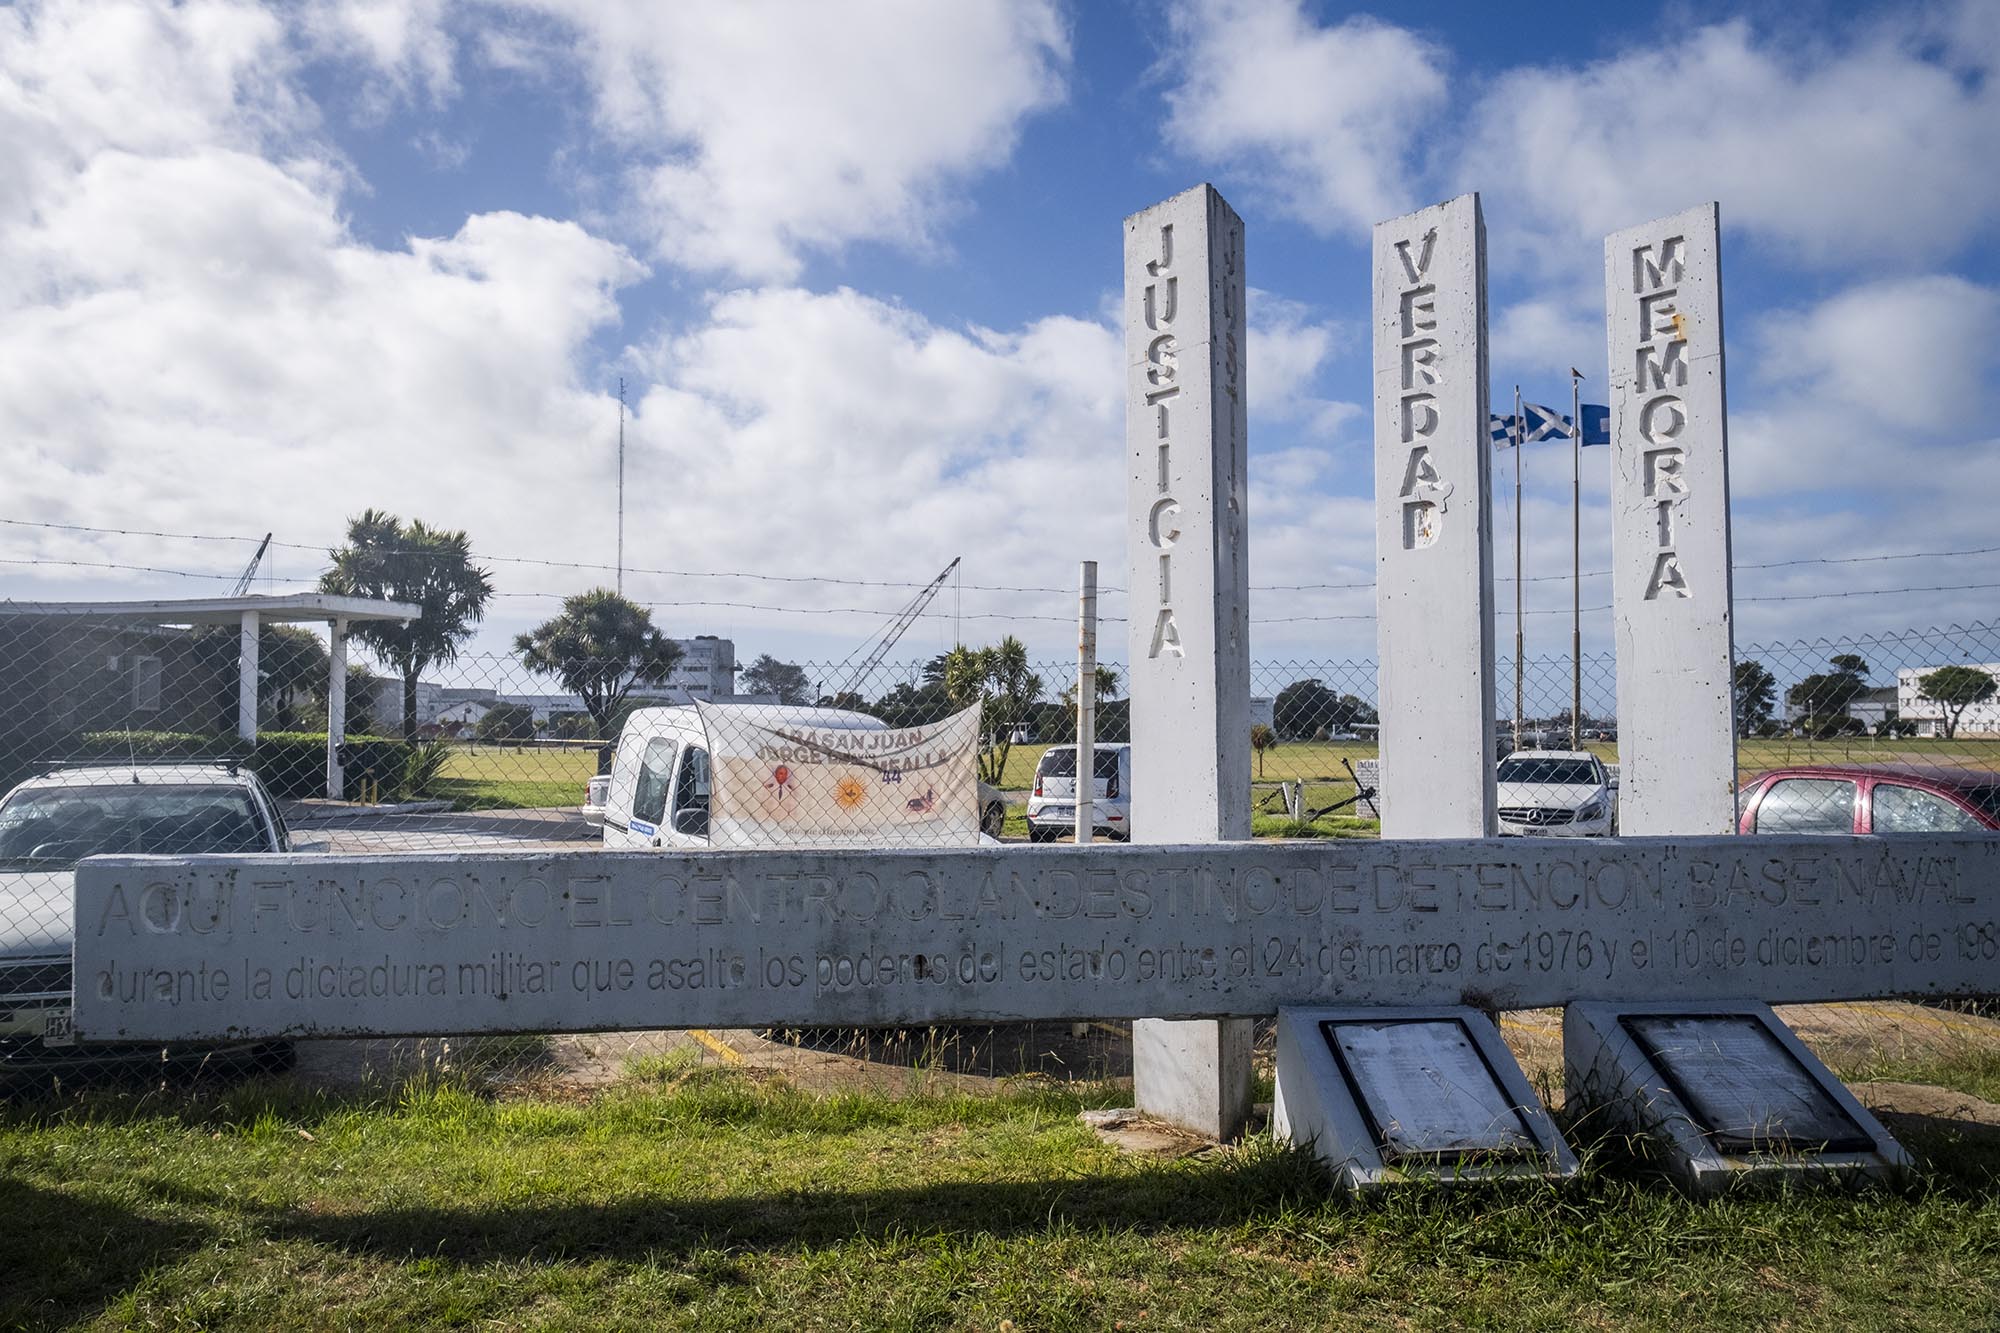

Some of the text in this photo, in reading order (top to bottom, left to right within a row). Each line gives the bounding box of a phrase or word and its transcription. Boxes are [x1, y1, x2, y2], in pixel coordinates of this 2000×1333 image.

[1394, 226, 1444, 551] VERDAD
[1631, 234, 1694, 601] MEMORIA
[1144, 222, 1187, 660] JUSTICIA
[882, 769, 903, 785] 44
[568, 874, 633, 928] EL
[646, 869, 882, 926] CENTRO
[902, 866, 1280, 923] CLANDESTINO
[1292, 864, 1361, 917] DE
[96, 959, 231, 1005] durante
[244, 957, 273, 1001] la
[284, 954, 447, 1000] dictadura
[458, 952, 561, 998] militar
[572, 958, 635, 1002] que
[759, 945, 806, 990] los
[957, 940, 1006, 985] del
[1019, 938, 1127, 982] estado
[1137, 940, 1218, 982] entre
[1228, 936, 1255, 979] el
[1264, 936, 1306, 978] 24
[1317, 933, 1358, 976] de
[1366, 942, 1463, 976] marzo
[1476, 931, 1514, 973] de
[1519, 928, 1593, 972] 1976
[1602, 937, 1620, 980] y
[1630, 930, 1656, 969] el
[1667, 928, 1702, 969] 10
[1712, 928, 1748, 967] de
[1756, 926, 1896, 968] diciembre
[1909, 923, 1943, 963] de
[1947, 920, 2000, 962] 198
[47, 1017, 70, 1036] HX
